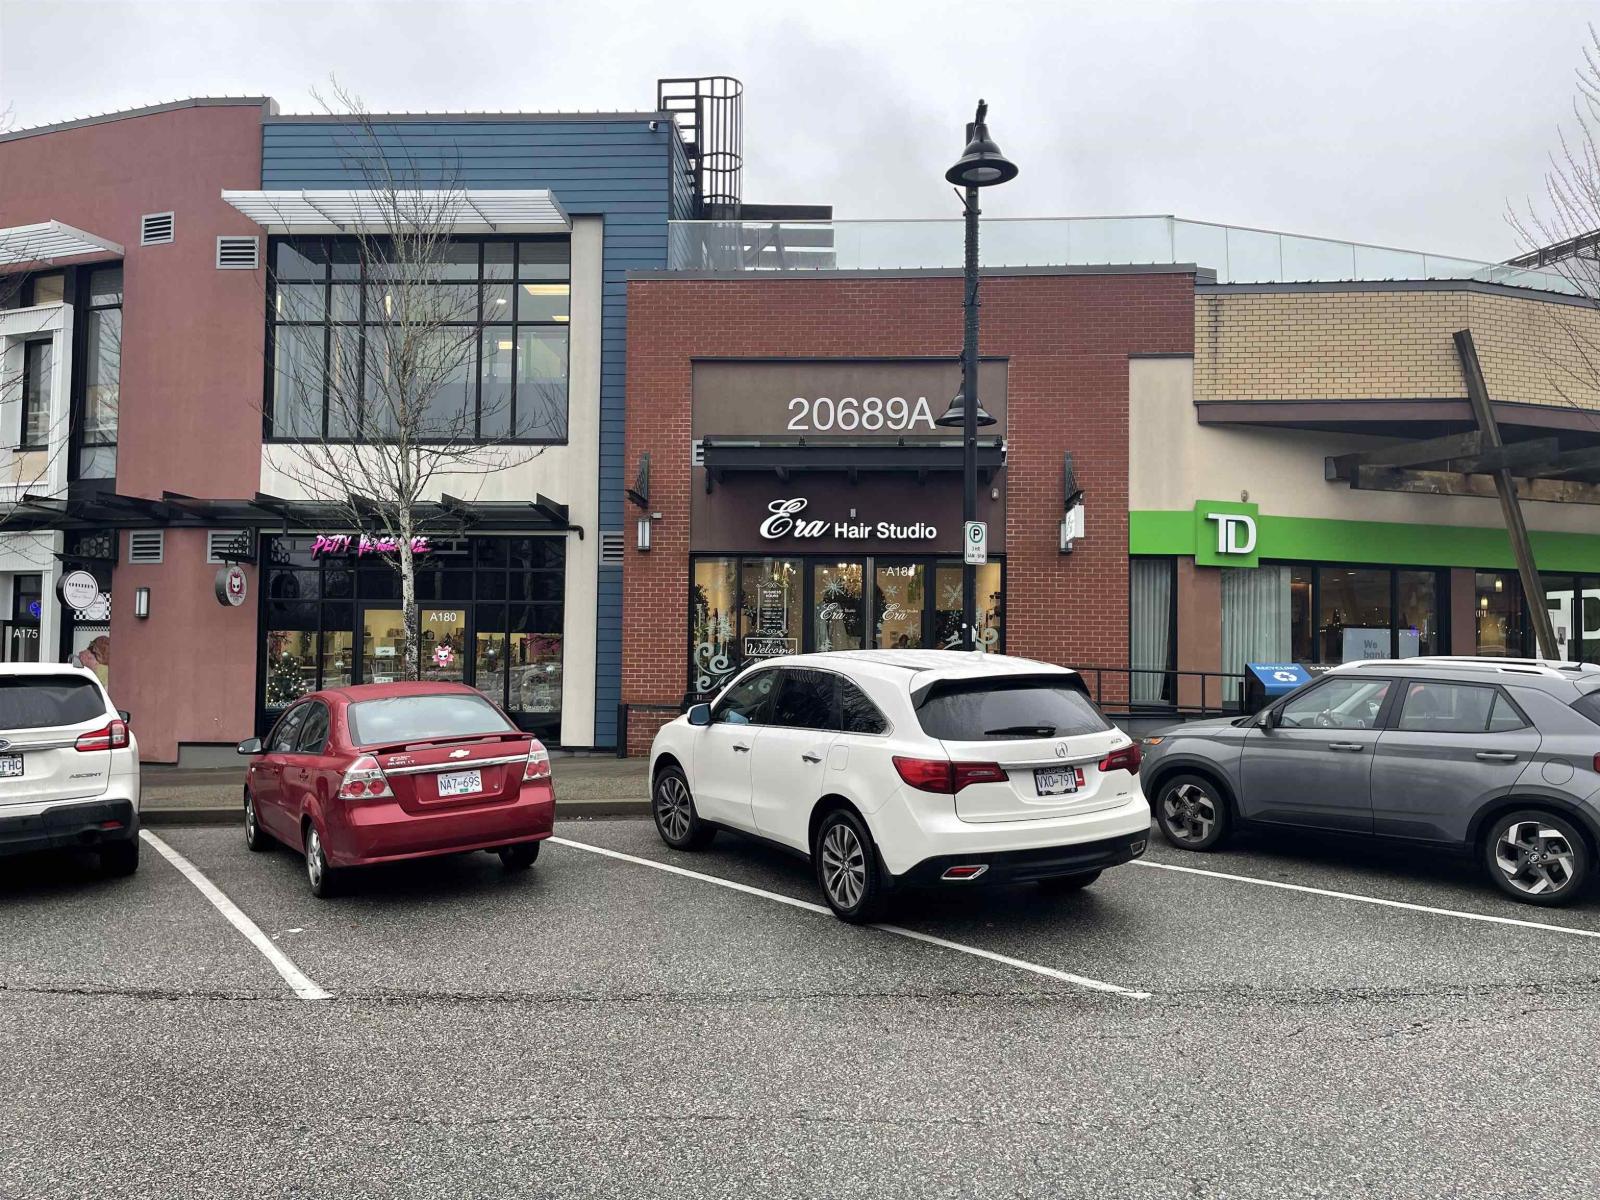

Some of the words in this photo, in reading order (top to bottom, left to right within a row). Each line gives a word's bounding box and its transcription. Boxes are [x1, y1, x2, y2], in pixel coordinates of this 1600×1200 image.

[787, 396, 936, 430] 20689A
[760, 497, 830, 539] Era
[834, 522, 872, 539] Hair
[876, 522, 937, 539] Studio
[1207, 512, 1257, 554] TD
[430, 612, 457, 622] A180
[820, 602, 846, 620] Era
[882, 602, 908, 620] Era
[13, 628, 38, 639] A175
[747, 643, 797, 655] Welcome
[1364, 639, 1378, 649] We
